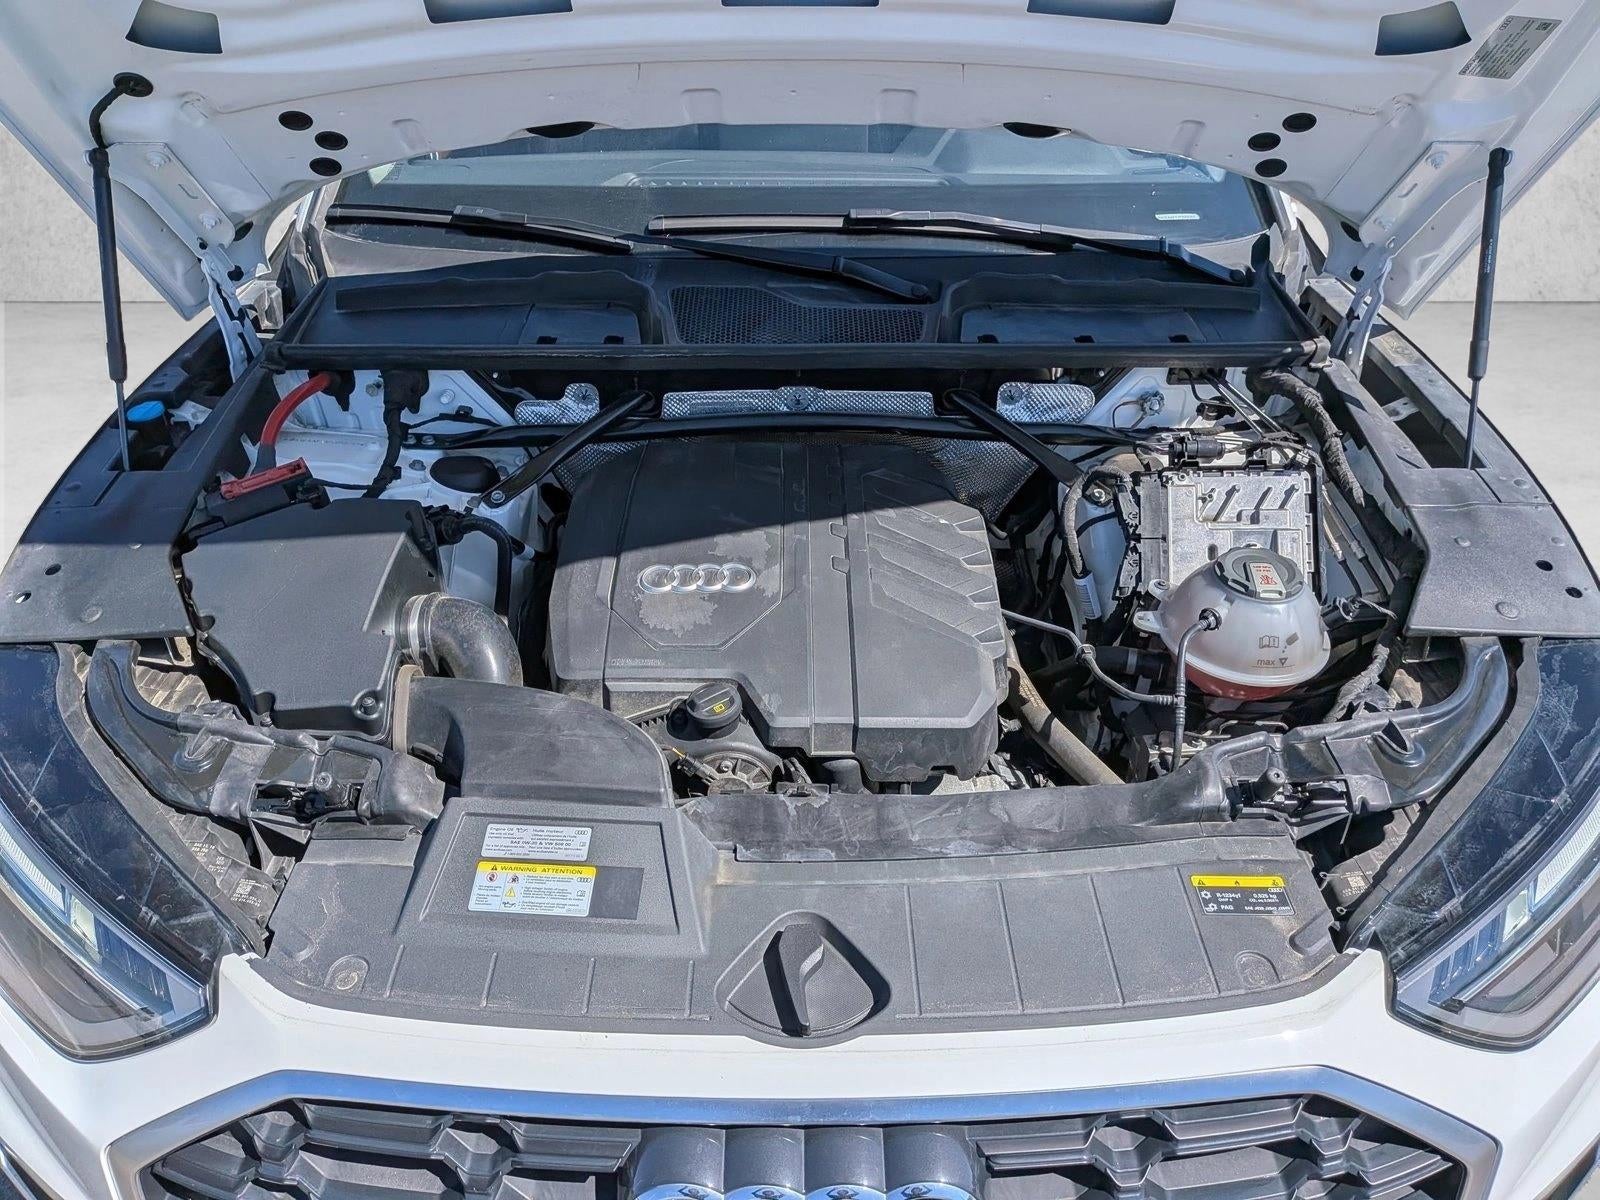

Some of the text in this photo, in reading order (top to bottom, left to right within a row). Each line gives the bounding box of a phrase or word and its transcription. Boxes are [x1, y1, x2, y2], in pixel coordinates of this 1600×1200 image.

[1256, 657, 1276, 666] max
[500, 865, 583, 875] WARNING ATTENTION
